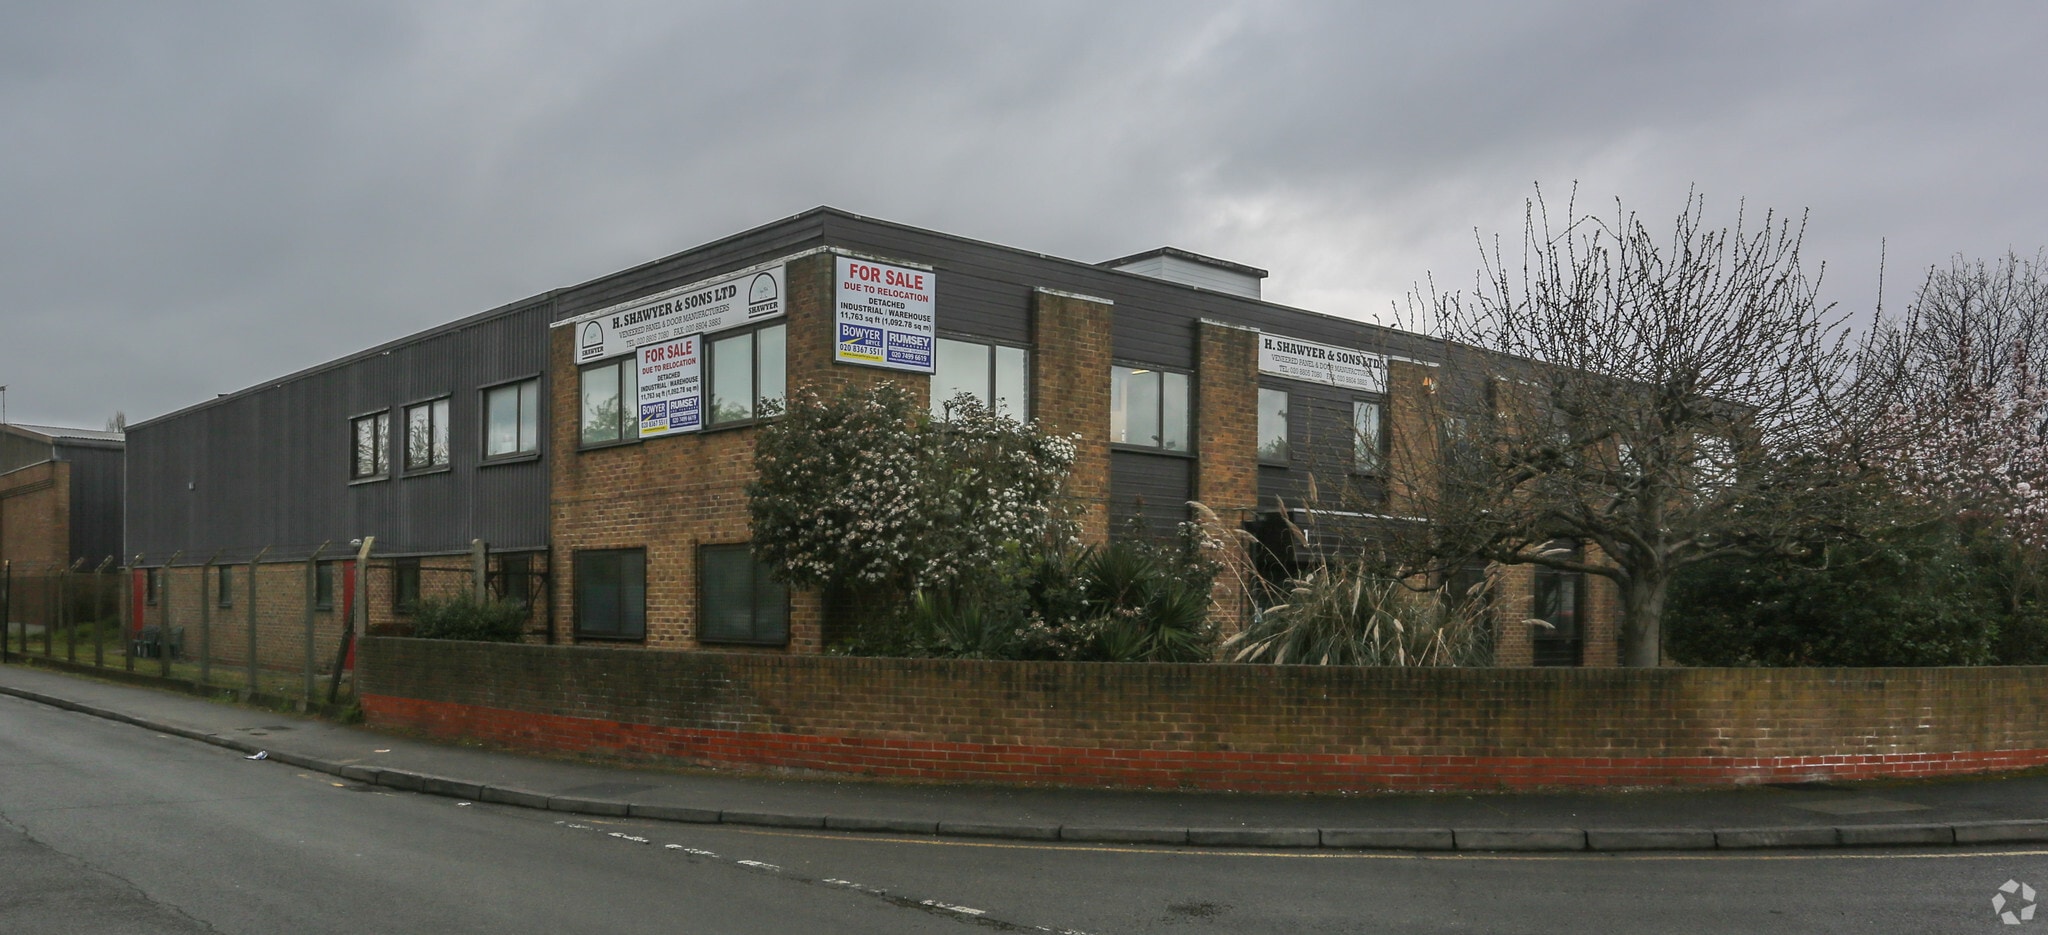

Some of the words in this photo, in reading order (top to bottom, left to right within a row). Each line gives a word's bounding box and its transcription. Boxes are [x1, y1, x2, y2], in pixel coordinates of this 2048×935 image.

[850, 263, 880, 283] FOR
[885, 270, 923, 290] SALE
[844, 282, 861, 292] DUE
[864, 285, 875, 294] TO
[878, 288, 928, 302] RELOCATION
[612, 317, 623, 329] H.
[624, 302, 672, 326] SHAWYER
[675, 300, 683, 313] &
[684, 291, 712, 310] SONS
[715, 285, 737, 301] LTD
[748, 302, 778, 314] SHAWYER
[869, 298, 905, 310] DETACHED
[840, 302, 883, 315] INDUSTRIAL
[889, 309, 931, 322] WAREHOUSE
[619, 326, 645, 339] VENEERED
[646, 322, 661, 332] PANEL
[666, 315, 683, 326] DOOR
[683, 304, 730, 322] MANUFACTURERS
[840, 311, 863, 321] 11,763
[865, 316, 873, 324] sq
[882, 318, 912, 328] (1,092.78
[923, 324, 932, 332] m)
[842, 325, 880, 340] BOWYER
[889, 333, 929, 346] RUMSEY
[582, 346, 604, 356] SHAWYER
[645, 347, 665, 364] FOR
[667, 341, 692, 359] SALE
[853, 345, 867, 353] 8367
[870, 348, 883, 356] 5511
[1264, 339, 1275, 350] H.
[1277, 341, 1325, 359] SHAWYER
[1328, 351, 1334, 361] &
[1336, 352, 1360, 365] SONS
[1362, 355, 1381, 369] LTD
[663, 357, 696, 370] RELOCATION
[1272, 354, 1298, 364] VENEERED
[1299, 359, 1314, 368] PANEL
[658, 371, 680, 381] DETACHED
[641, 382, 667, 392] INDUSTRIAL
[670, 376, 698, 386] WAREHOUSE
[643, 404, 665, 415] BOWYER
[671, 397, 697, 410] RUMSEY
